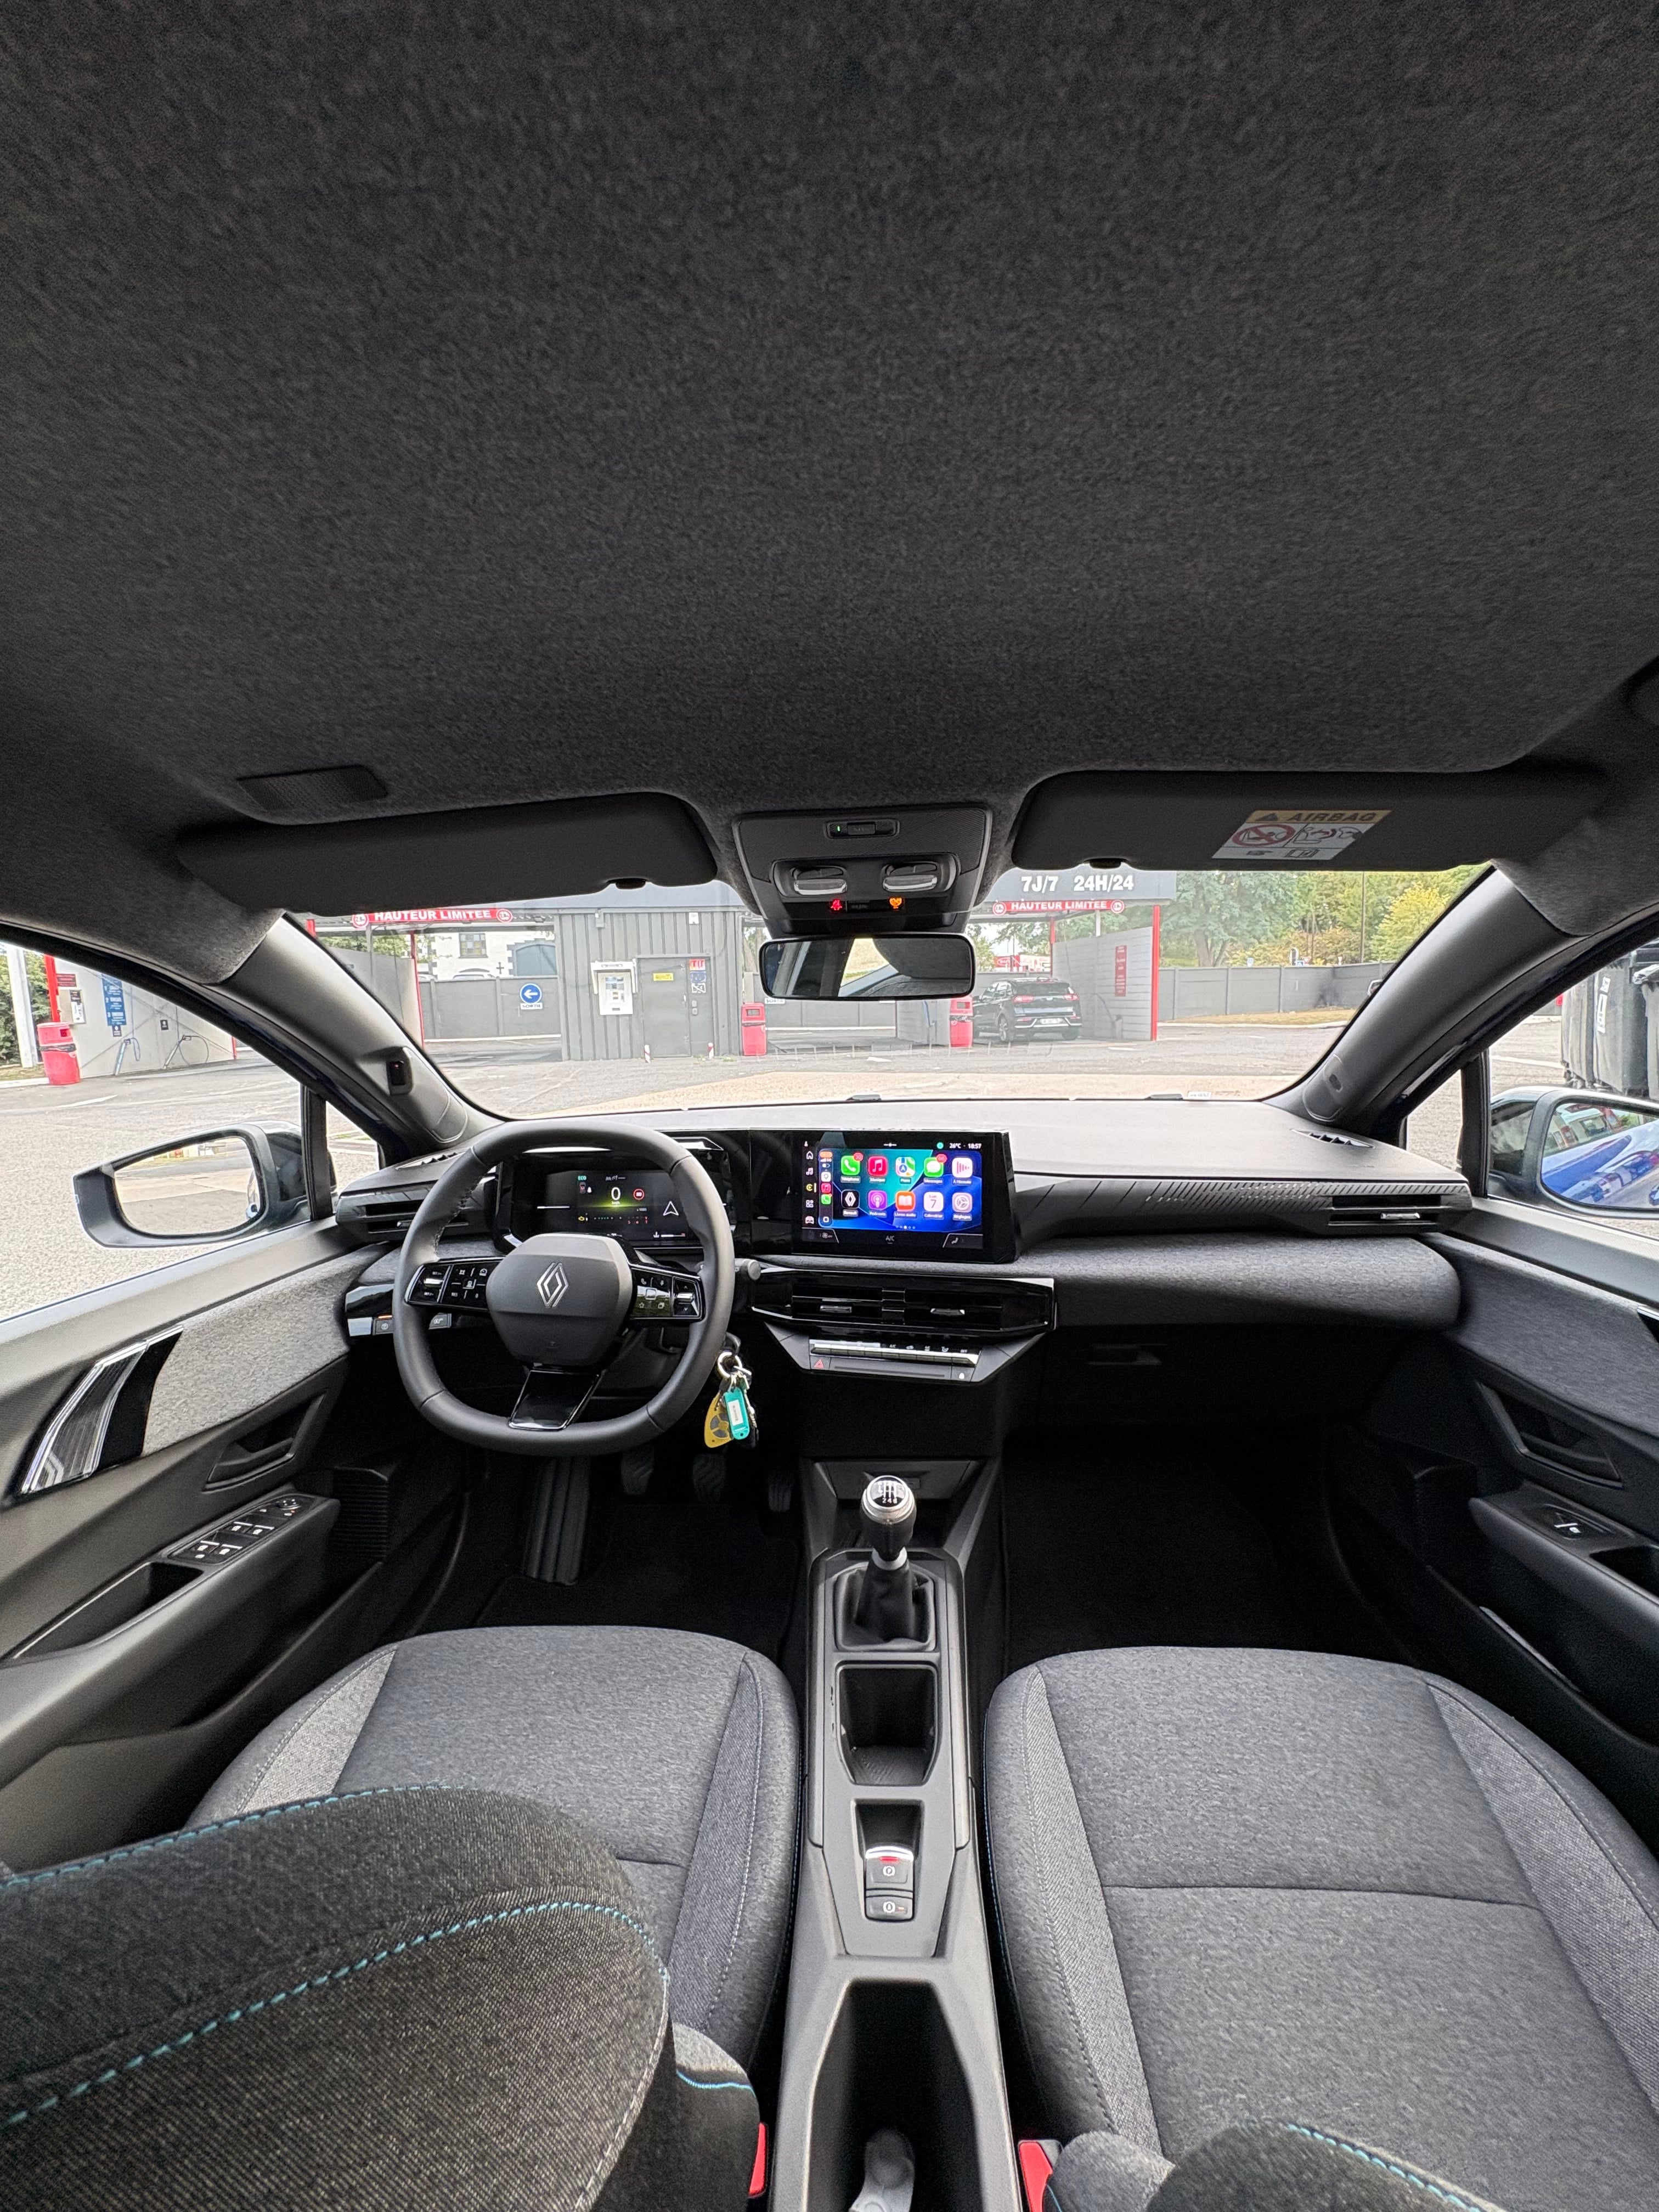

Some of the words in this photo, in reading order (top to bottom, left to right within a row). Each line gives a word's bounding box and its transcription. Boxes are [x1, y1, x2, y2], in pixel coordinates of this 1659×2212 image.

[1286, 812, 1376, 822] AIRBAG
[1022, 876, 1058, 893] 7J/7
[1074, 875, 1134, 893] 24H/24
[1011, 901, 1062, 910] HAUTEUR
[374, 909, 437, 921] HAUTEUR
[611, 1187, 620, 1200] 0
